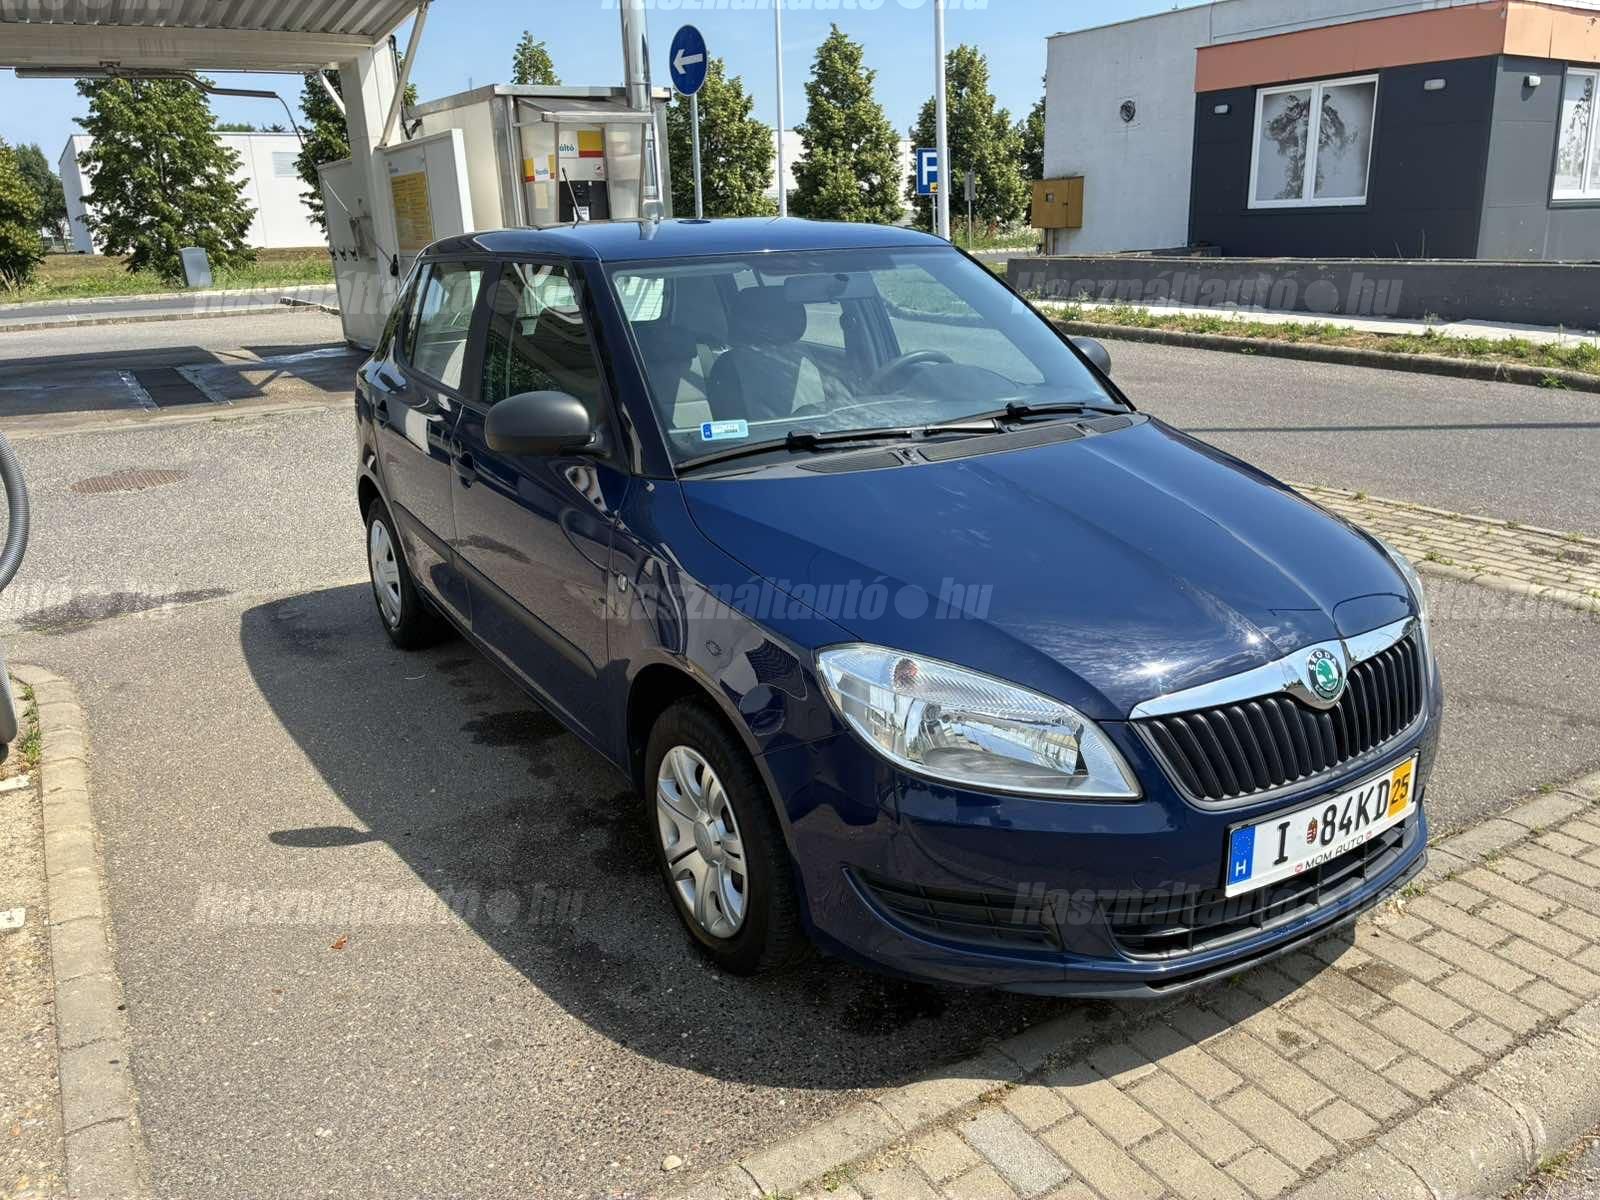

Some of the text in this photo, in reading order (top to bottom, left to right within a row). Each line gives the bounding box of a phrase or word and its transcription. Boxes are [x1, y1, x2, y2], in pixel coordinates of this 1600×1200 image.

[1320, 779, 1391, 846] 84KD
[1391, 772, 1411, 805] 25
[1234, 860, 1247, 877] H
[1304, 834, 1365, 870] MOM AUTO
